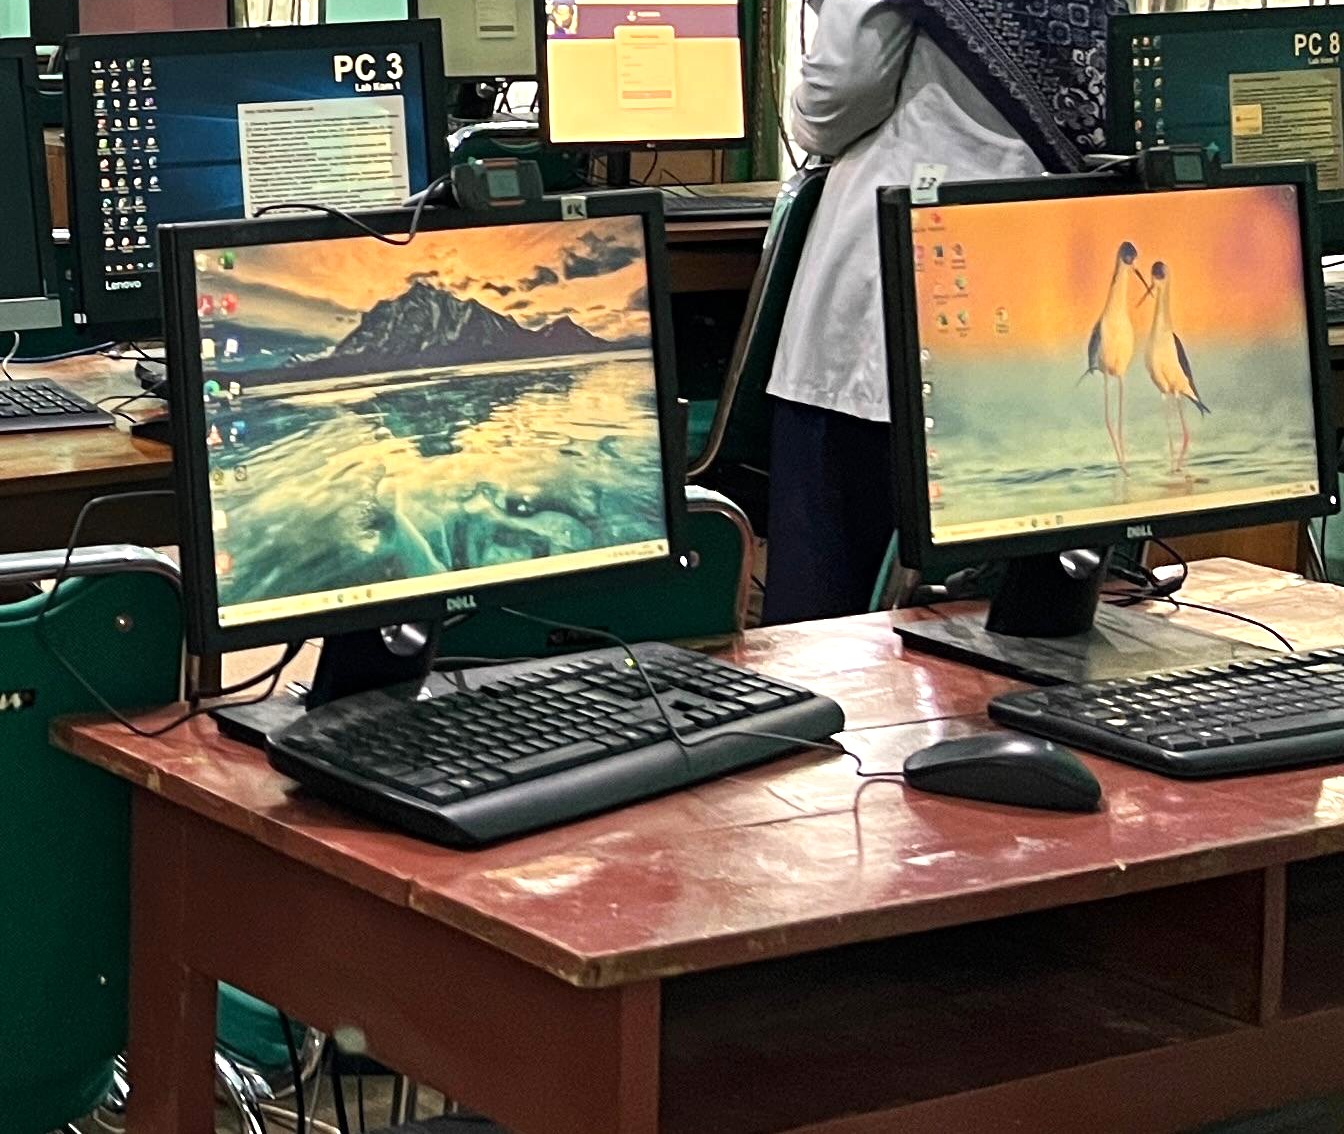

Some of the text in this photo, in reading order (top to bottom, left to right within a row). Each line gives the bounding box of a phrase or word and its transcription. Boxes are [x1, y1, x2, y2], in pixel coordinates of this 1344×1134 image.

[1294, 31, 1341, 56] PC 8
[334, 52, 404, 83] PC 3
[105, 280, 142, 291] Lenovo
[1126, 525, 1153, 539] DELL
[446, 594, 477, 611] DELL
